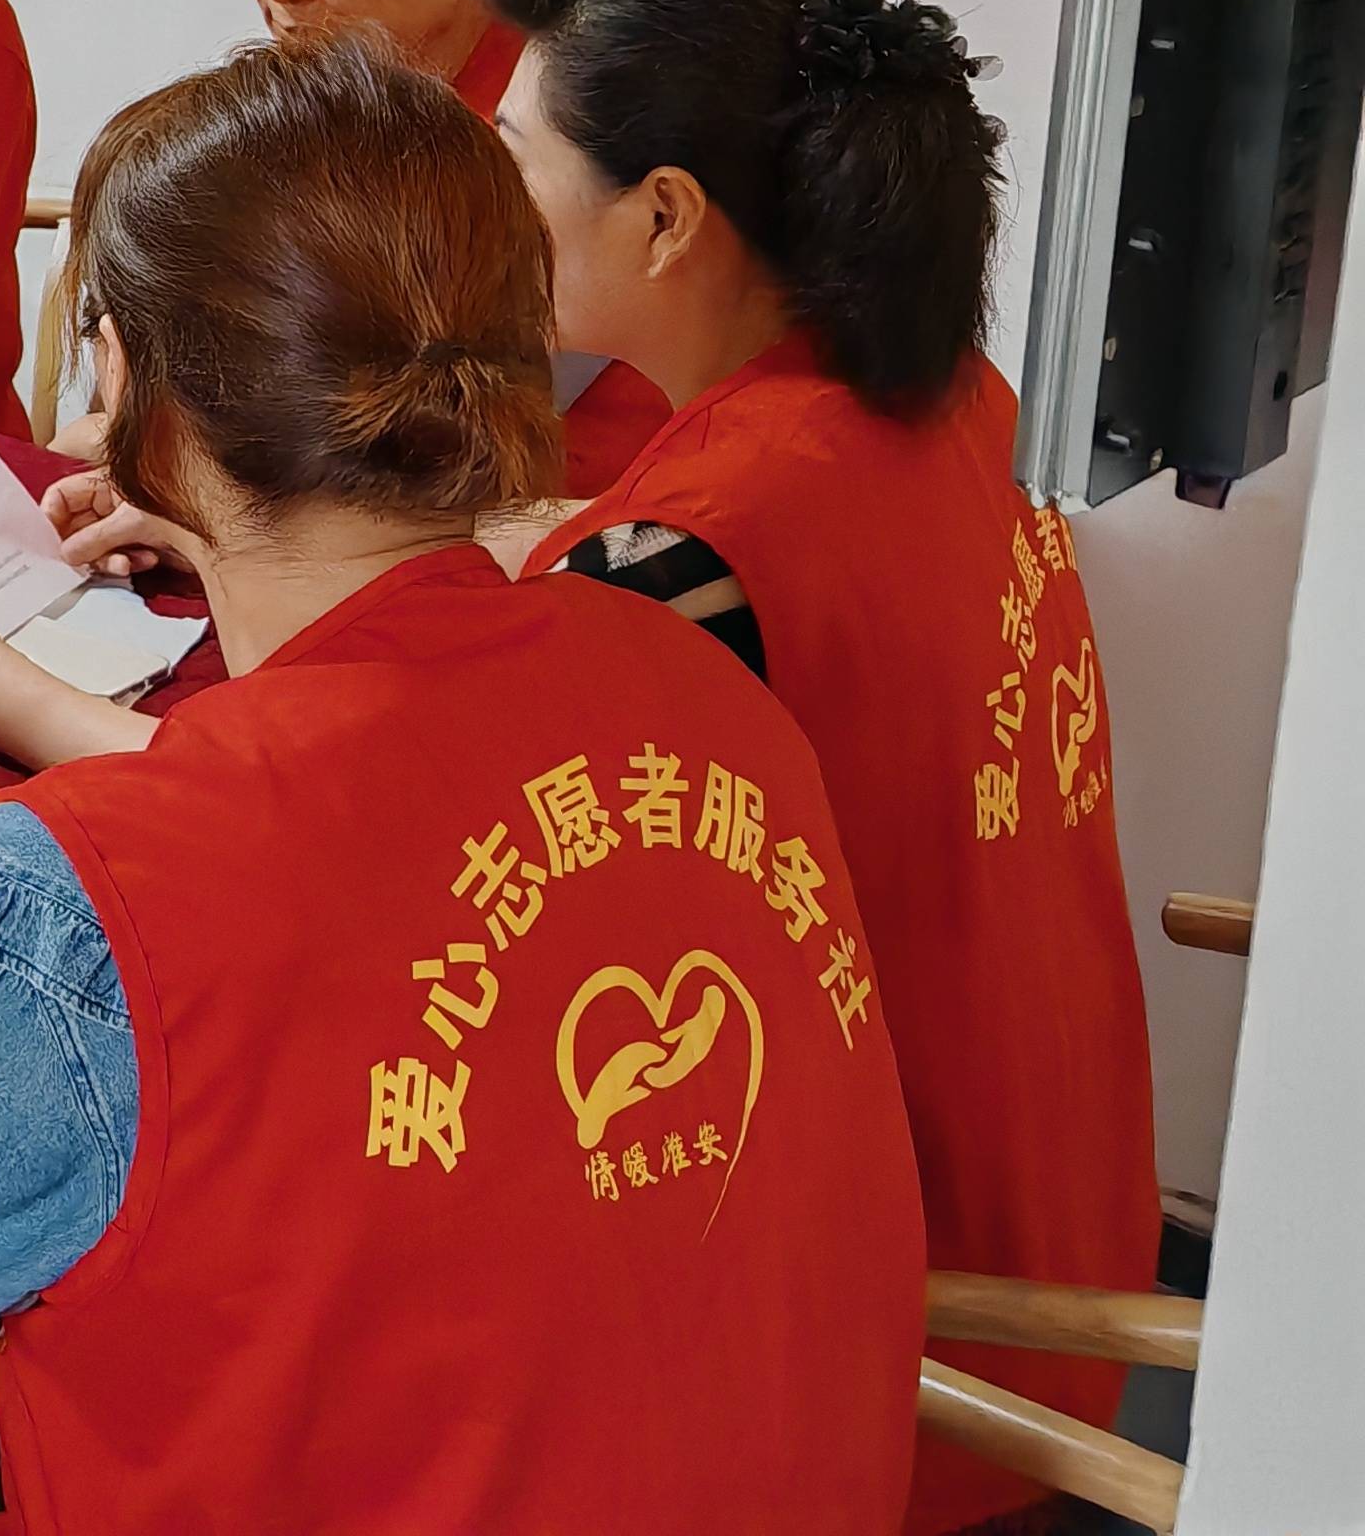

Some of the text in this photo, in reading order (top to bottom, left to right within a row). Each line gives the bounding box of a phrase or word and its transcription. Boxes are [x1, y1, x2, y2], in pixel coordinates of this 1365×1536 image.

[974, 507, 1078, 841] 爱心志愿者
[365, 742, 872, 1173] 爱心志愿者服务社
[584, 1120, 729, 1202] 情暖淮安
